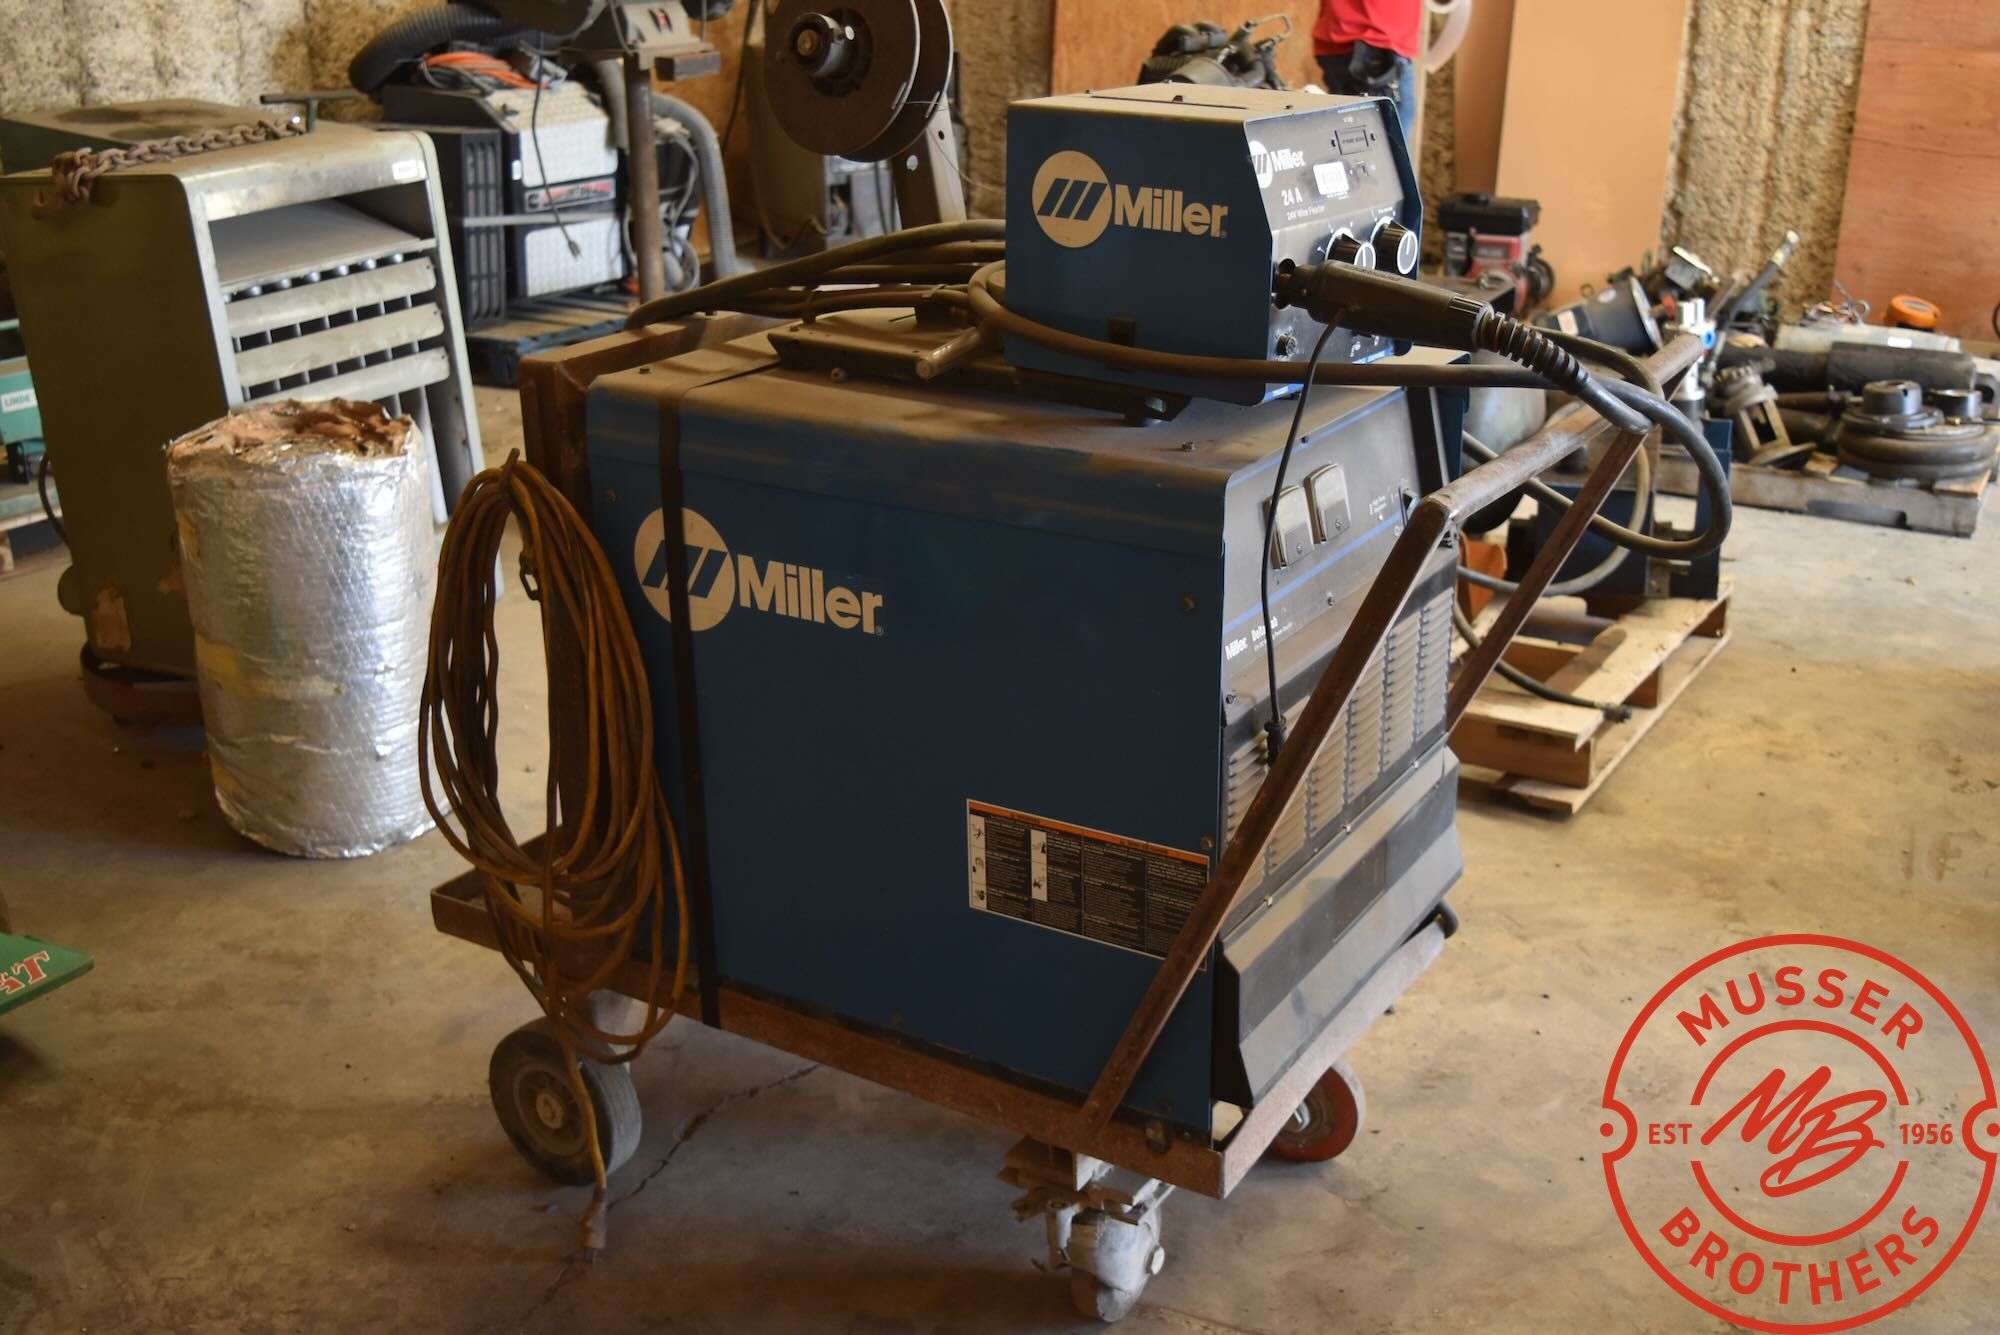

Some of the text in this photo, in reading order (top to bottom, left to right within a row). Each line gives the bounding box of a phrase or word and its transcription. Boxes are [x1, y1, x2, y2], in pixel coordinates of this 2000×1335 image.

[1114, 183, 1229, 237] Miller
[1281, 188, 1295, 206] 24
[737, 553, 883, 635] Miller
